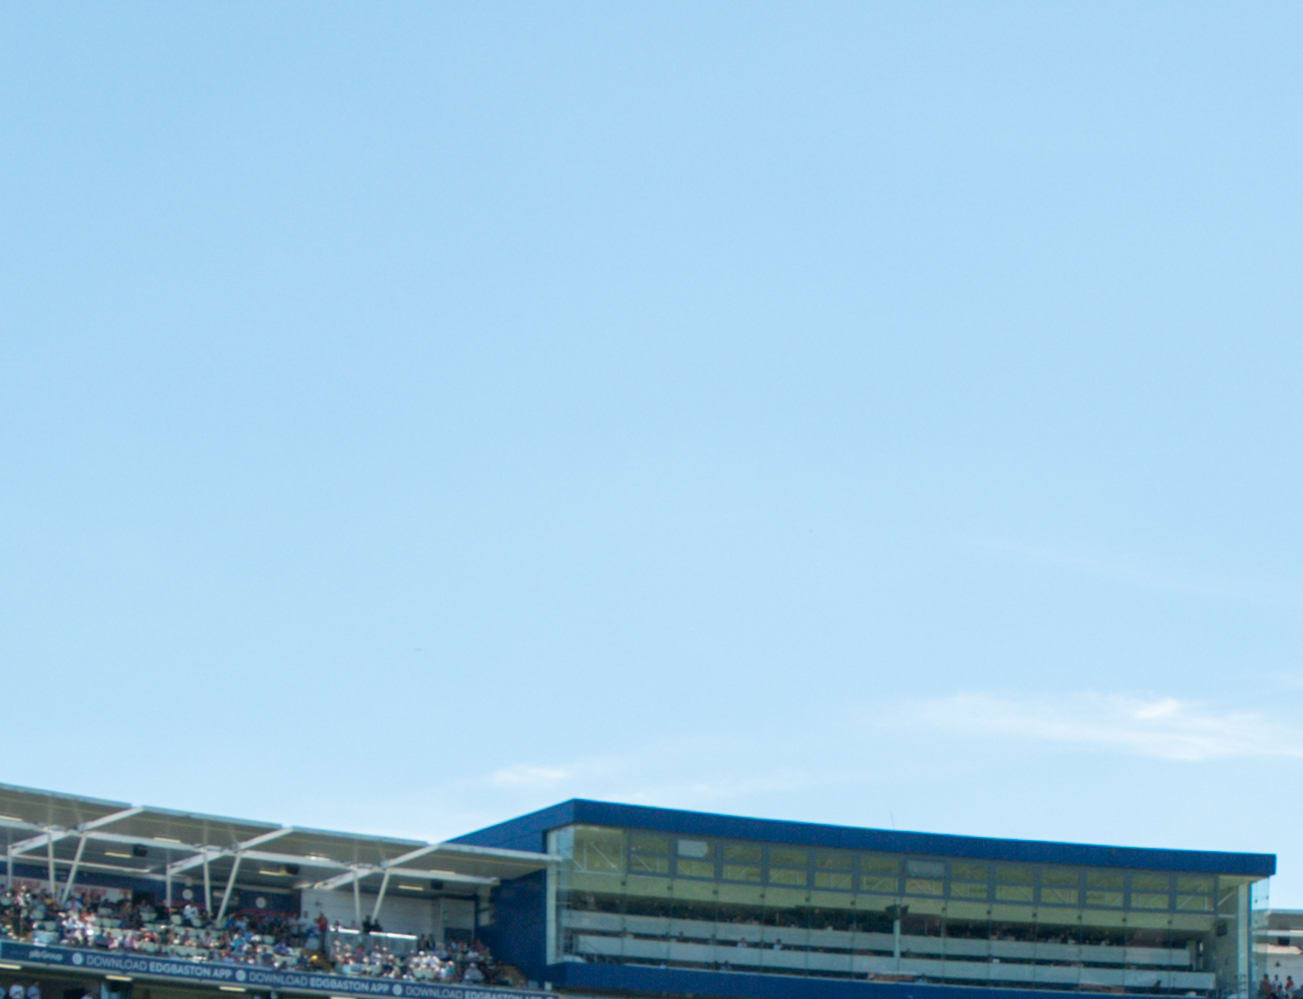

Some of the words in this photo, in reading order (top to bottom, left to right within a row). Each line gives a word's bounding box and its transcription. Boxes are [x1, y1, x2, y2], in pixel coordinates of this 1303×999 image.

[86, 954, 146, 971] DOWNLOAD
[149, 960, 211, 978] EDGBASTON
[212, 966, 232, 979] APP
[249, 971, 308, 986] DOWNLOAD
[310, 977, 369, 992] EDGBASTON
[370, 982, 389, 994] APP
[405, 985, 463, 999] DOWNLOAD
